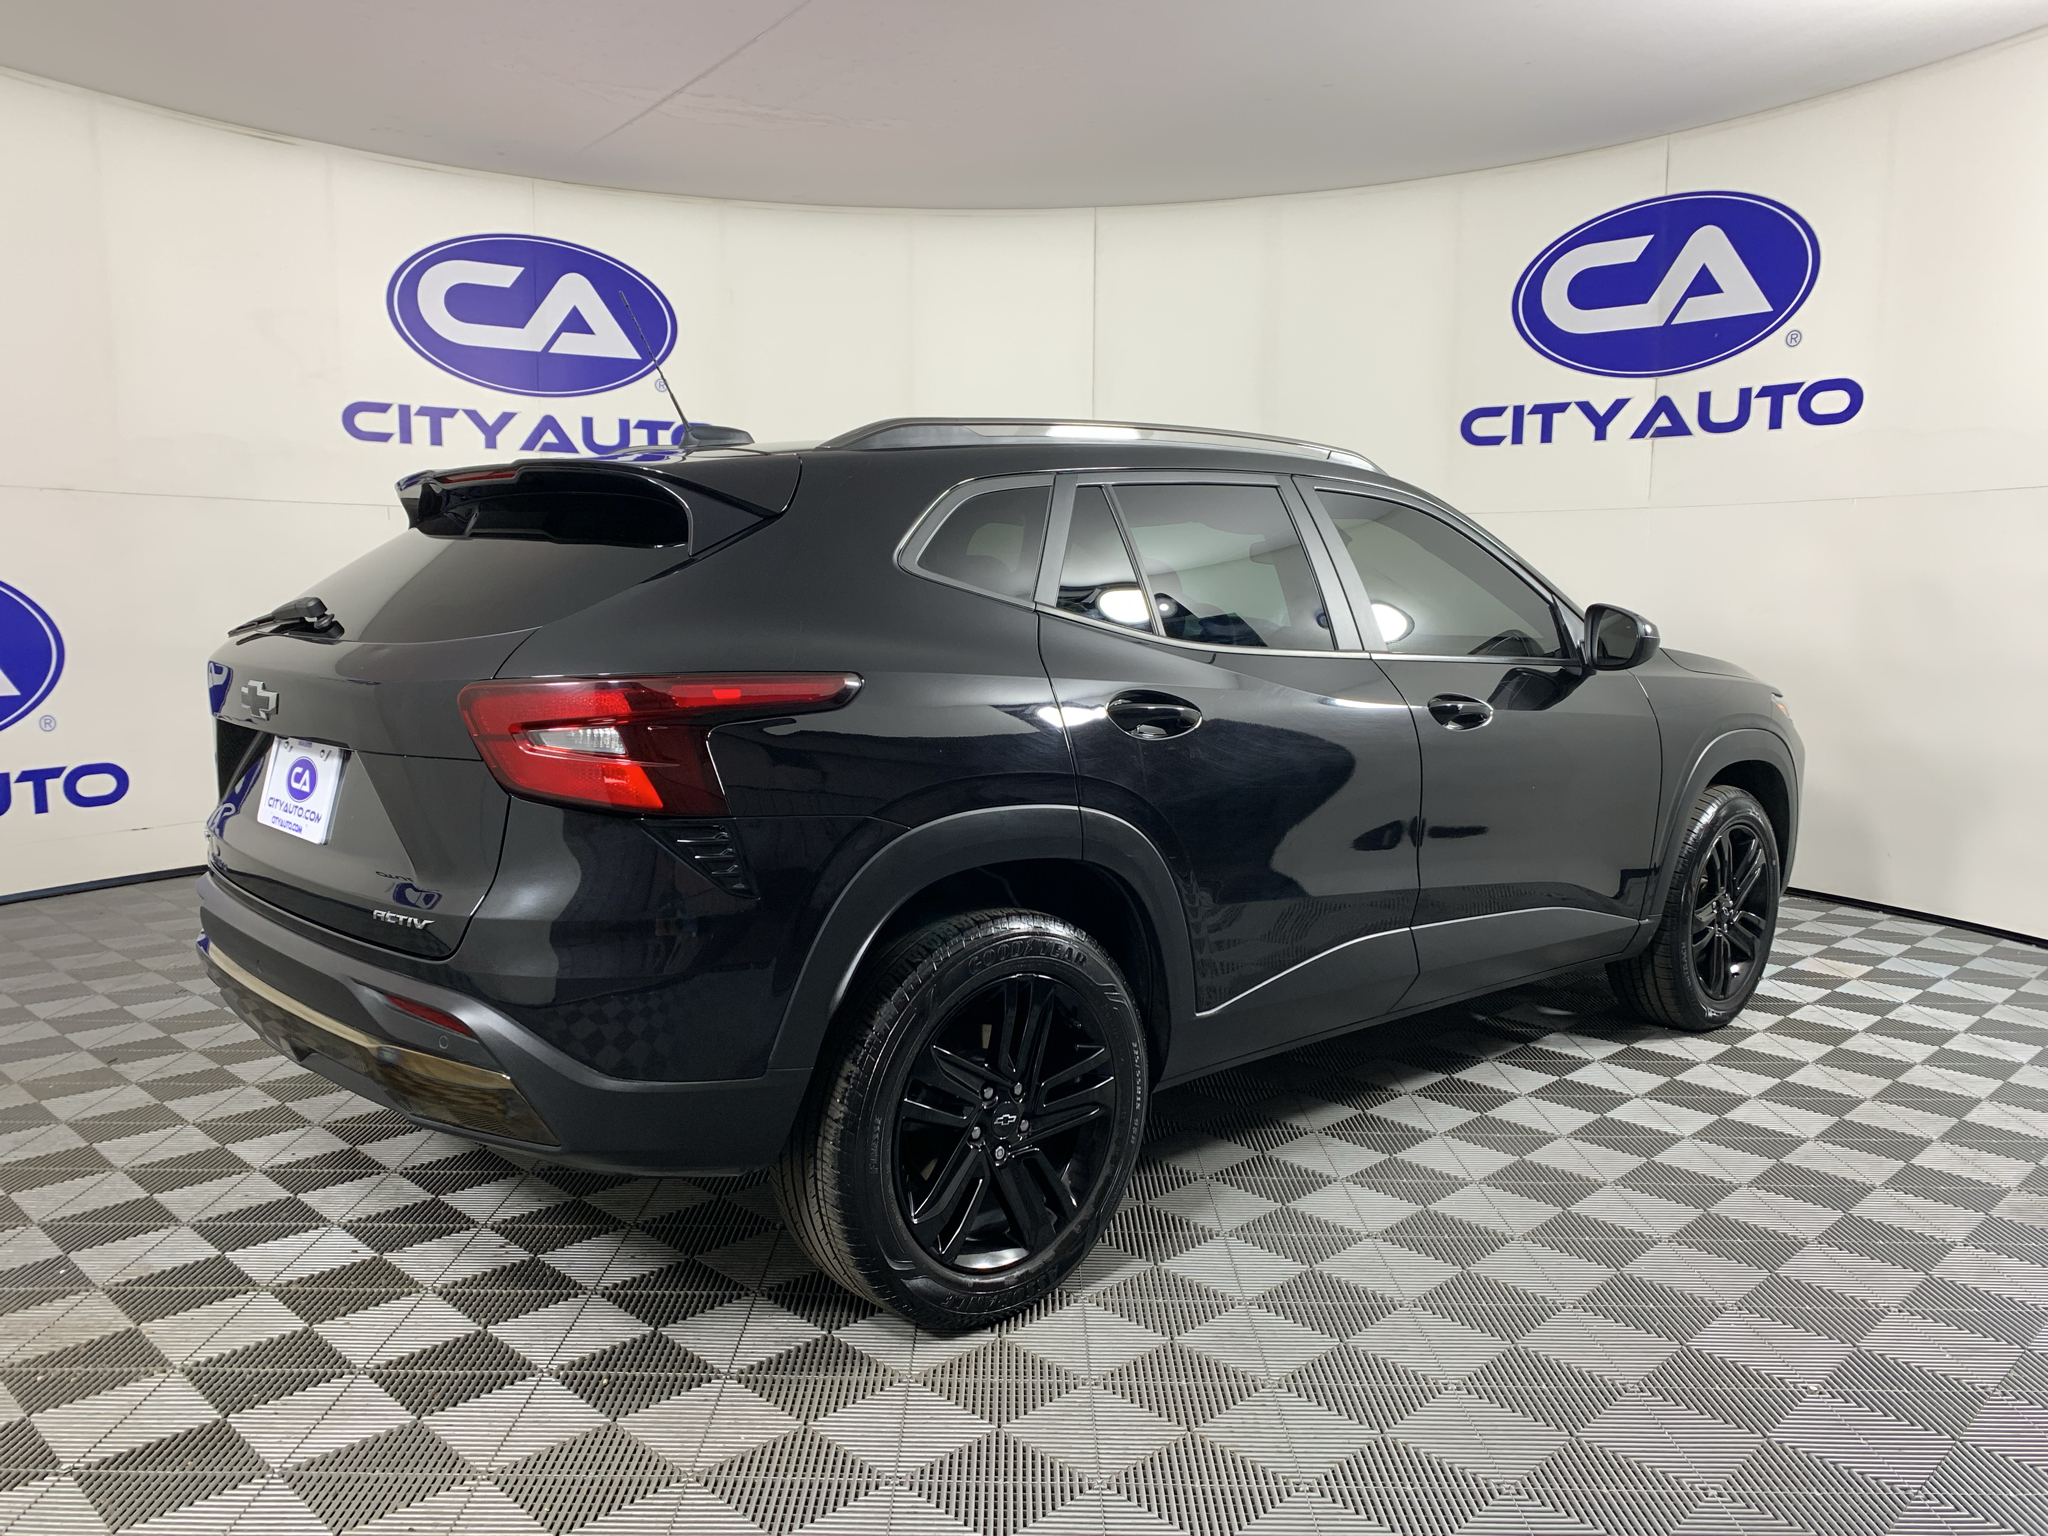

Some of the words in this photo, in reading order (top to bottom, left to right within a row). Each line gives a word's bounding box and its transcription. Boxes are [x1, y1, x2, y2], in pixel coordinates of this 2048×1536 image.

[417, 259, 642, 360] CA
[1541, 225, 1774, 334] CA
[0, 762, 129, 817] UTO
[290, 766, 310, 793] CA
